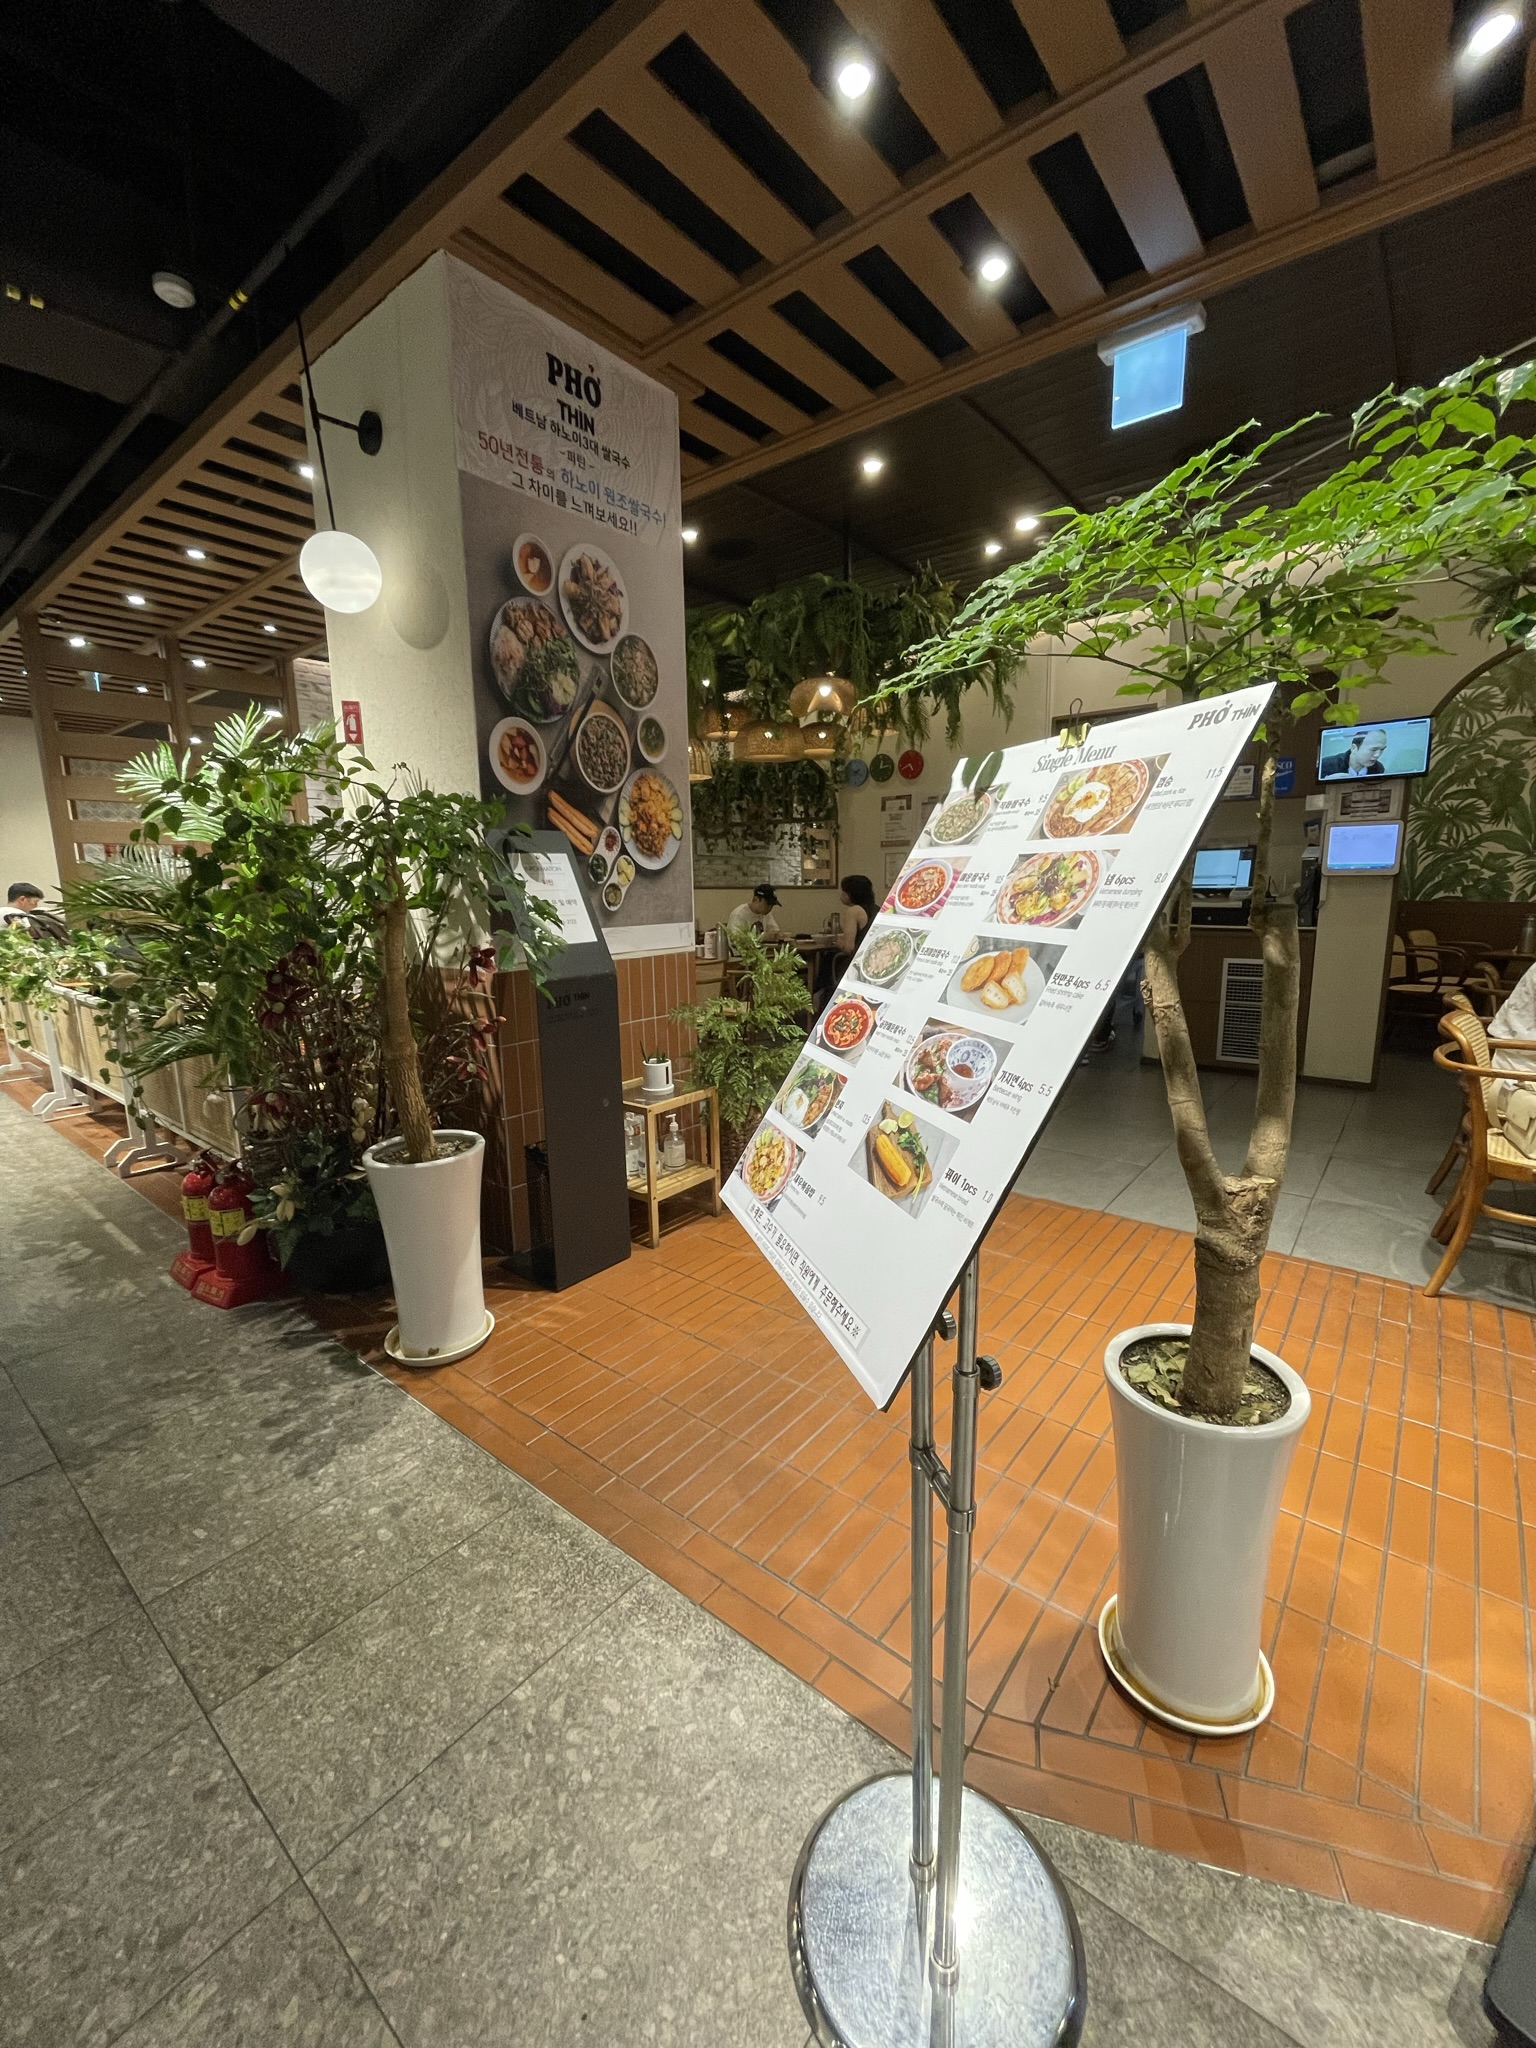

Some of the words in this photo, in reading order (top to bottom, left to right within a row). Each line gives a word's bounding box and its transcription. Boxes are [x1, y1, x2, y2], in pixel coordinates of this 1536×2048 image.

[512, 400, 547, 431] 베트남
[549, 419, 599, 456] 하노이3대
[601, 444, 630, 470] 쌀국수
[561, 467, 600, 501] 하노이
[511, 471, 525, 490] 그
[529, 477, 568, 509] 차이를
[571, 495, 637, 536] 느껴보세요!!
[1032, 748, 1073, 773] Single
[1073, 745, 1117, 765] Menu
[1276, 761, 1293, 769] SCO
[1115, 874, 1135, 886] 6pcs
[1154, 872, 1168, 884] 8.0
[1073, 977, 1091, 989] 4pcs
[1095, 979, 1111, 991] 6.5
[1017, 1078, 1033, 1092] 4pcs
[1038, 1083, 1053, 1096] 5.5
[961, 1178, 978, 1196] 1pcs
[983, 1190, 993, 1204] 1.0
[762, 1218, 777, 1239] 고수가
[775, 1233, 800, 1266] 필요하시면
[799, 1259, 820, 1291] 직원에게
